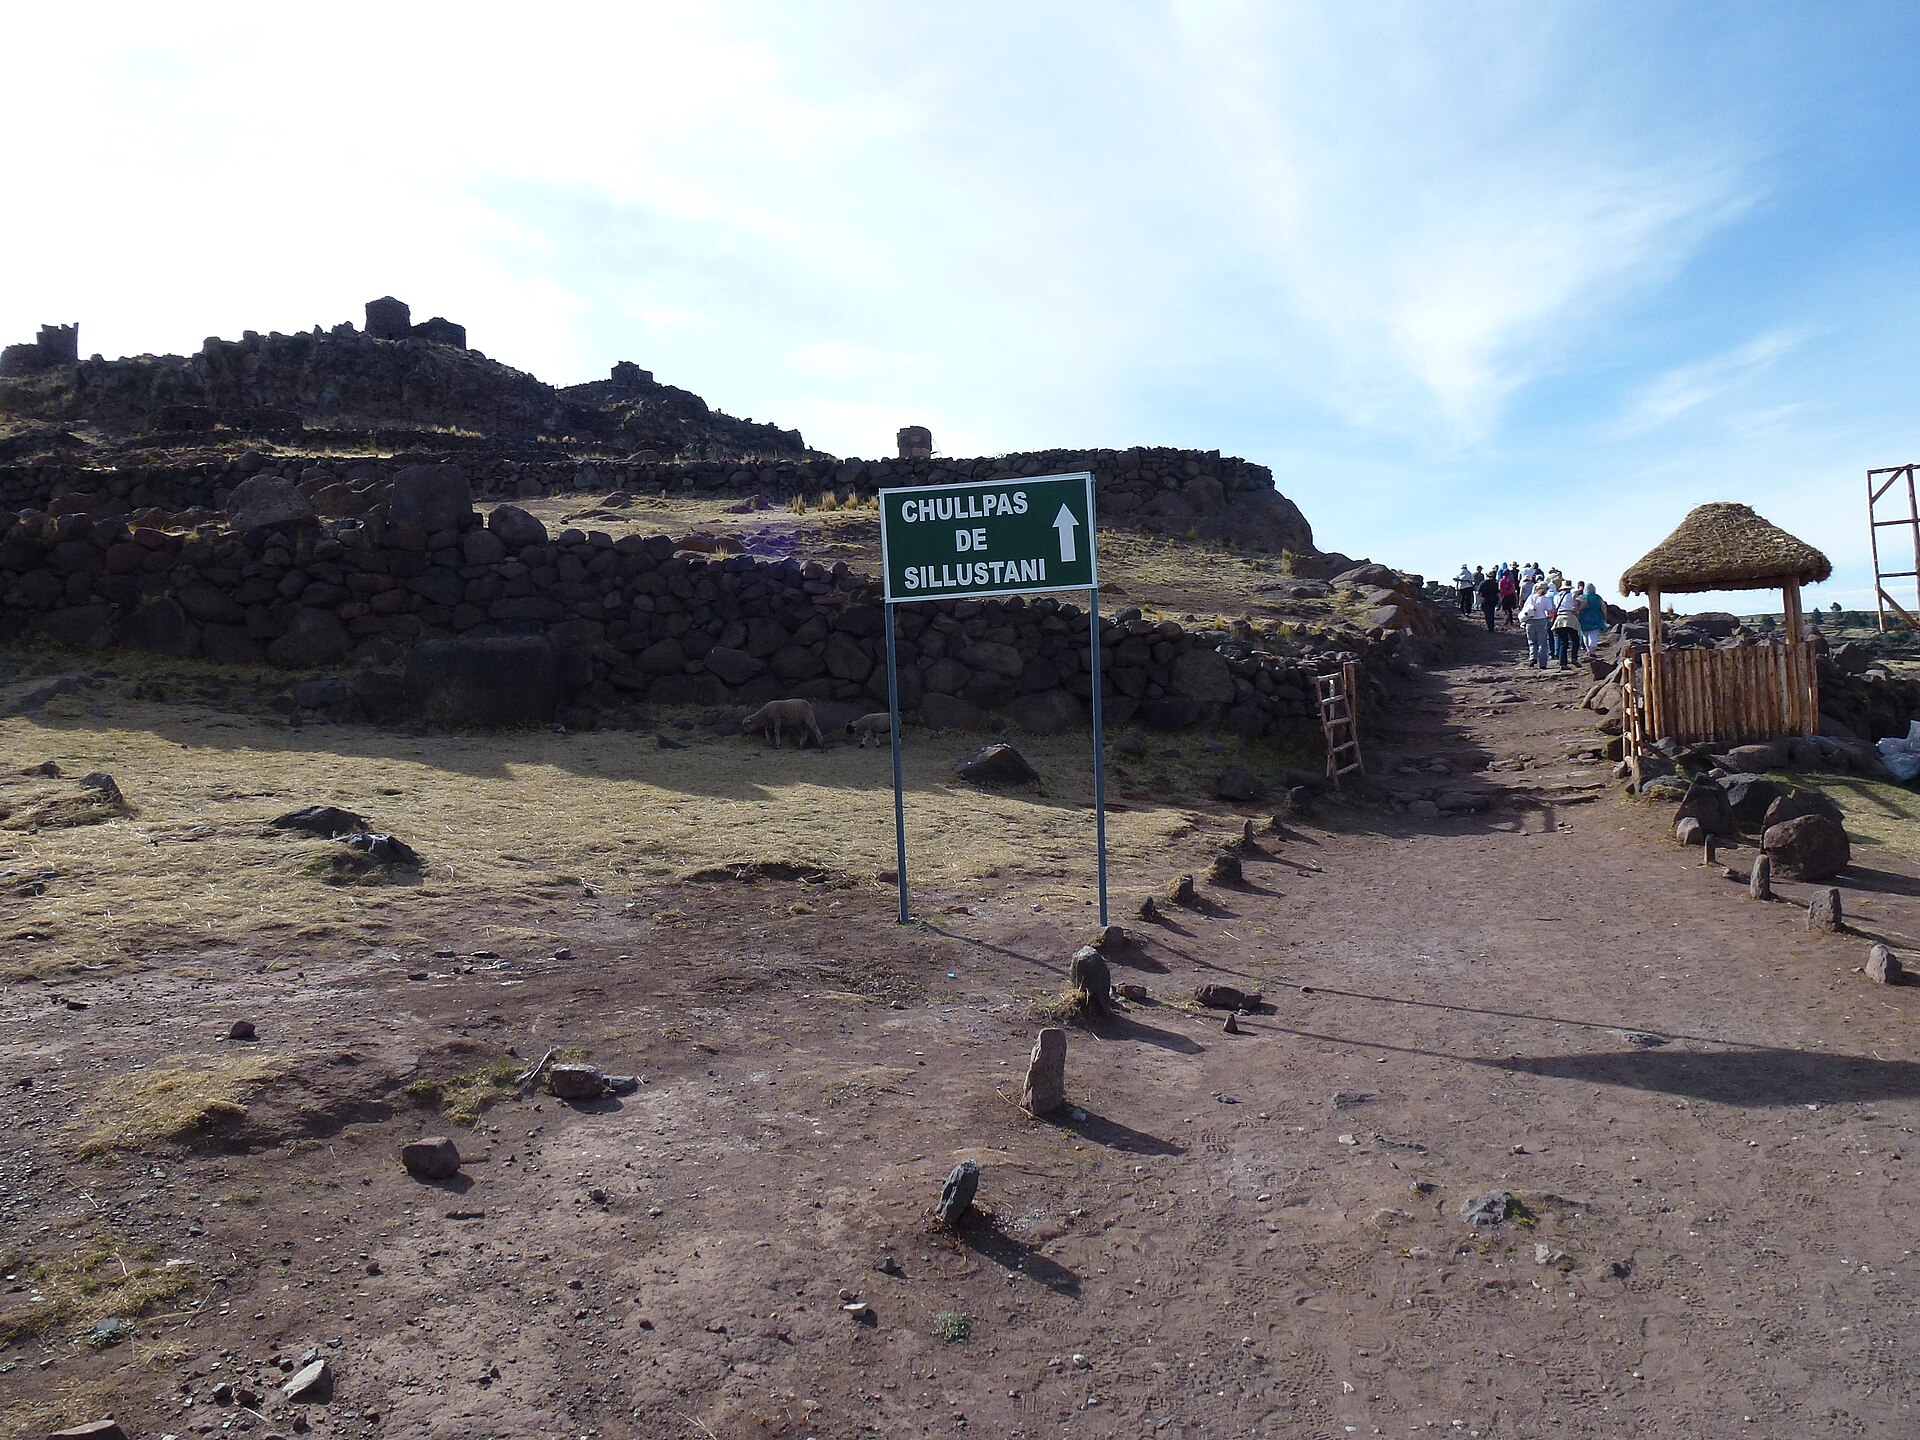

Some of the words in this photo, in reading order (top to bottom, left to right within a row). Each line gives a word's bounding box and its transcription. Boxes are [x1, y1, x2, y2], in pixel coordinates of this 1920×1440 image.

[901, 491, 1029, 523] CHULLPAS
[955, 528, 988, 552] DE
[904, 558, 1046, 590] SILLUSTANI
